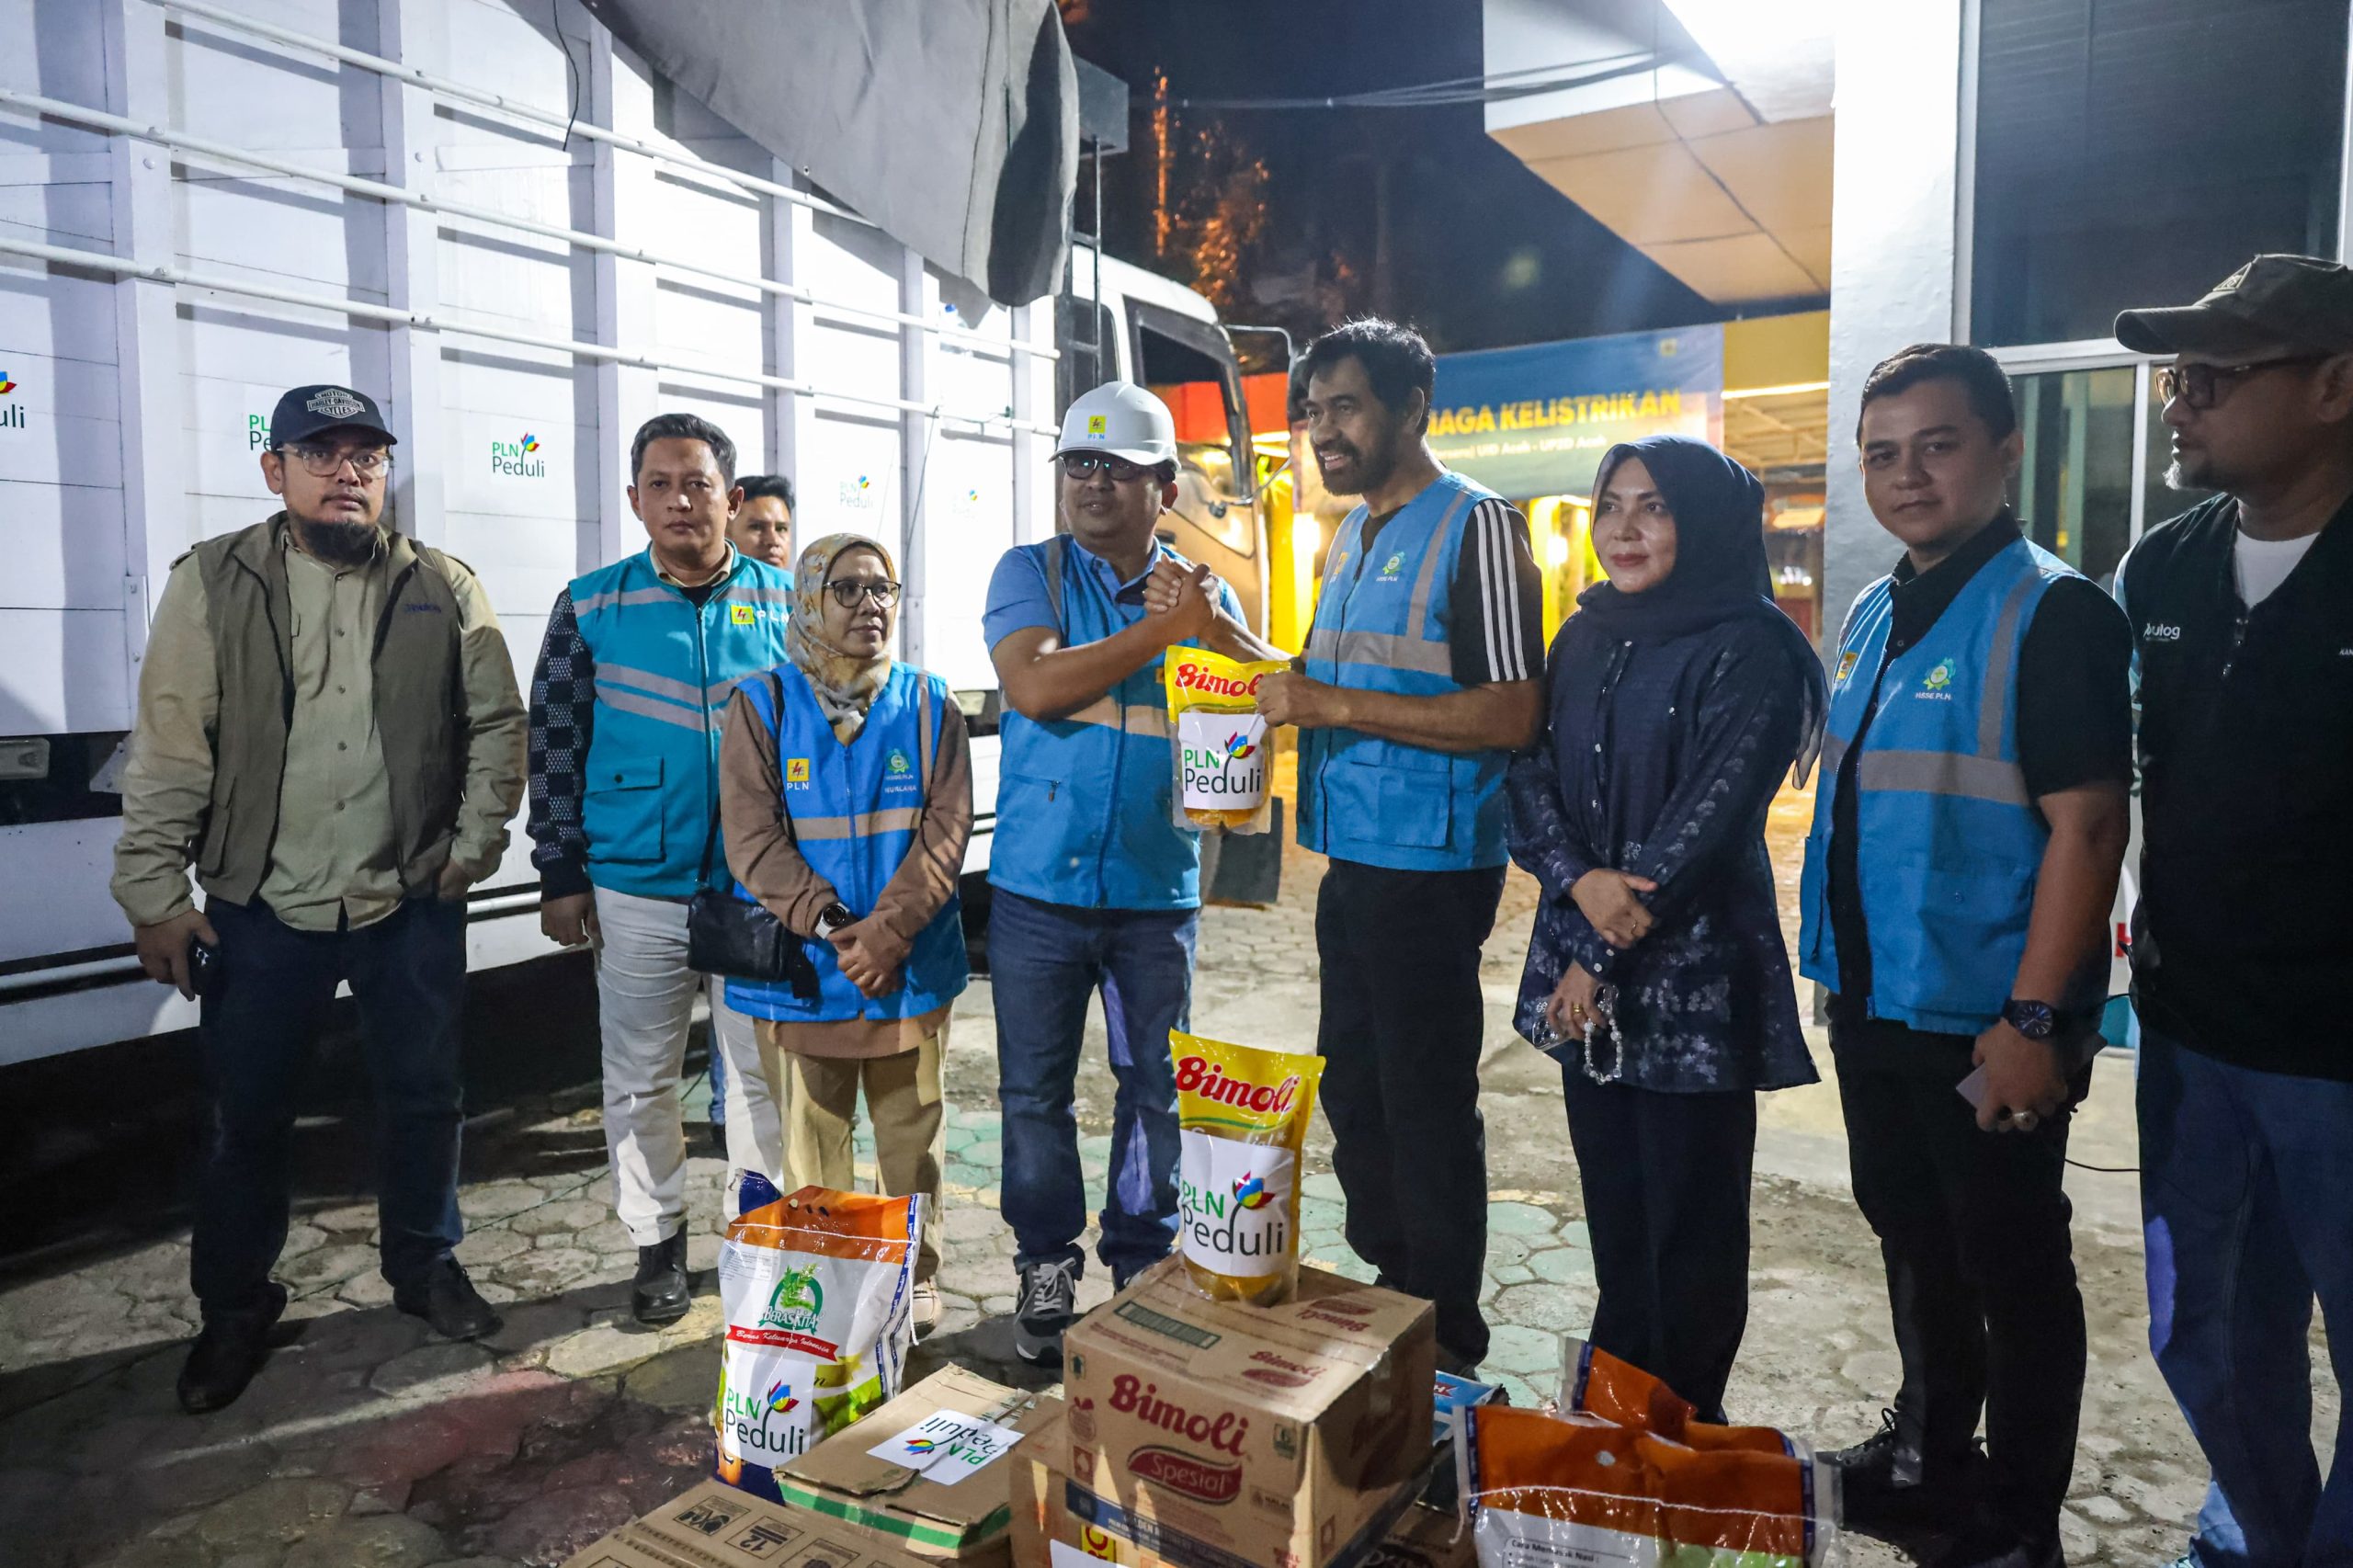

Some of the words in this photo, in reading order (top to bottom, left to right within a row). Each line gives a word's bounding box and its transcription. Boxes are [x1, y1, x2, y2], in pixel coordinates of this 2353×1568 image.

[249, 415, 270, 432] PL
[1426, 404, 1496, 437] IAGA
[1499, 388, 1682, 430] KELISTRIKAN
[493, 442, 518, 457] PLN
[493, 456, 544, 478] Peduli
[839, 492, 873, 508] Peduli
[756, 610, 790, 624] PLN
[1176, 664, 1265, 697] Bimol
[1935, 692, 1951, 700] PLN
[1184, 749, 1220, 768] PLN
[787, 782, 810, 790] PLN
[1184, 767, 1261, 794] Peduli
[1176, 1056, 1301, 1113] Bimoli
[1182, 1179, 1224, 1220] PLN
[1182, 1203, 1283, 1256] Peduli
[736, 1330, 759, 1340] Beras
[1248, 1350, 1327, 1378] Bimoli
[728, 1387, 761, 1421] PLN
[1108, 1374, 1249, 1457] Bimoli
[726, 1407, 804, 1455] Peduli
[1151, 1454, 1226, 1494] Spesial
[740, 1533, 764, 1551] 12
